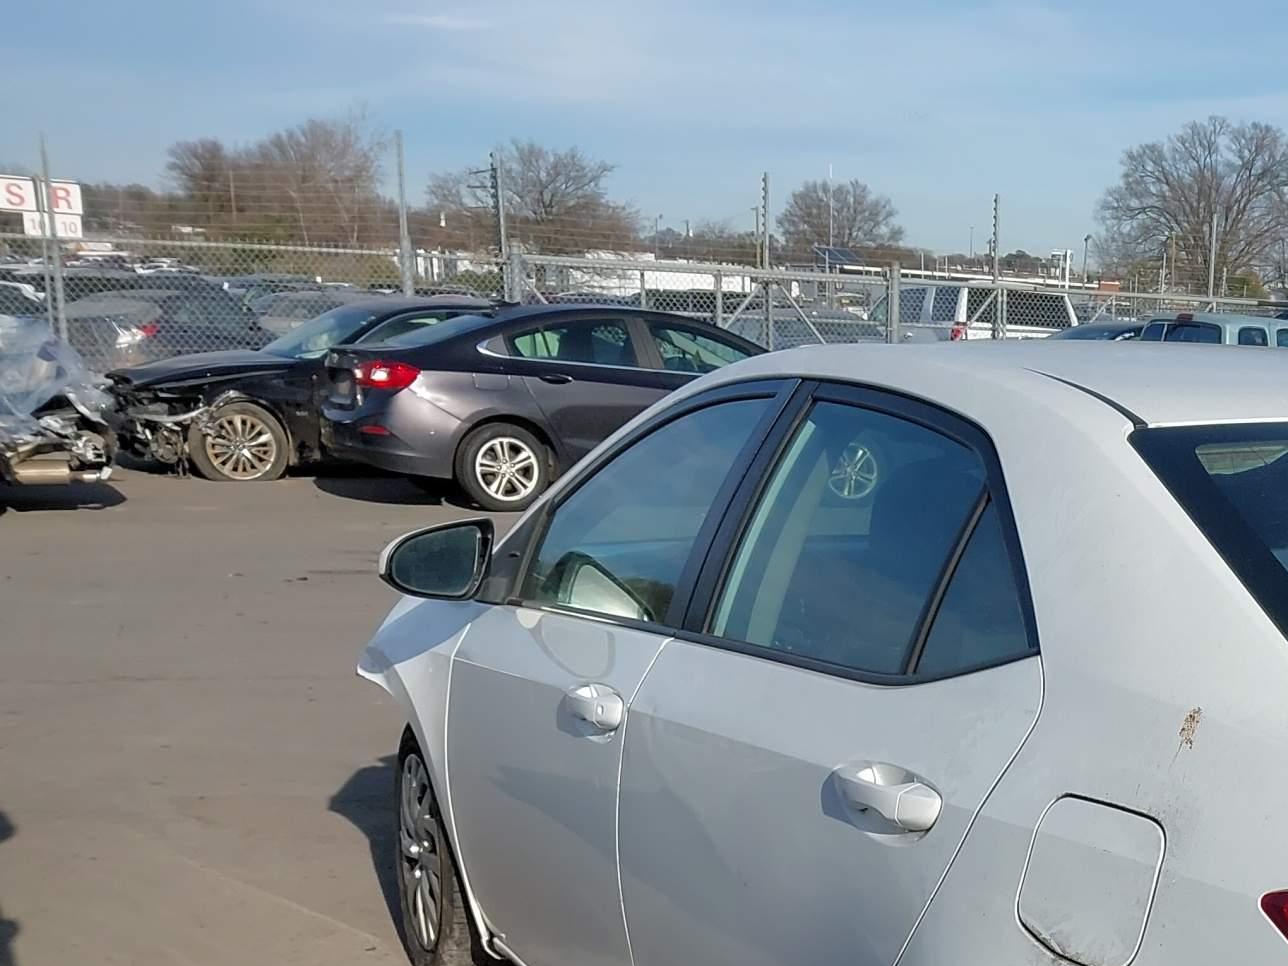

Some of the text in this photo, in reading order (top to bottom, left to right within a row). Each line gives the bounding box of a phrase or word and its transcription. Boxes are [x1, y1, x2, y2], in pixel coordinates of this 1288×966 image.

[5, 182, 25, 206] S
[50, 187, 73, 210] R
[61, 222, 78, 234] 10
